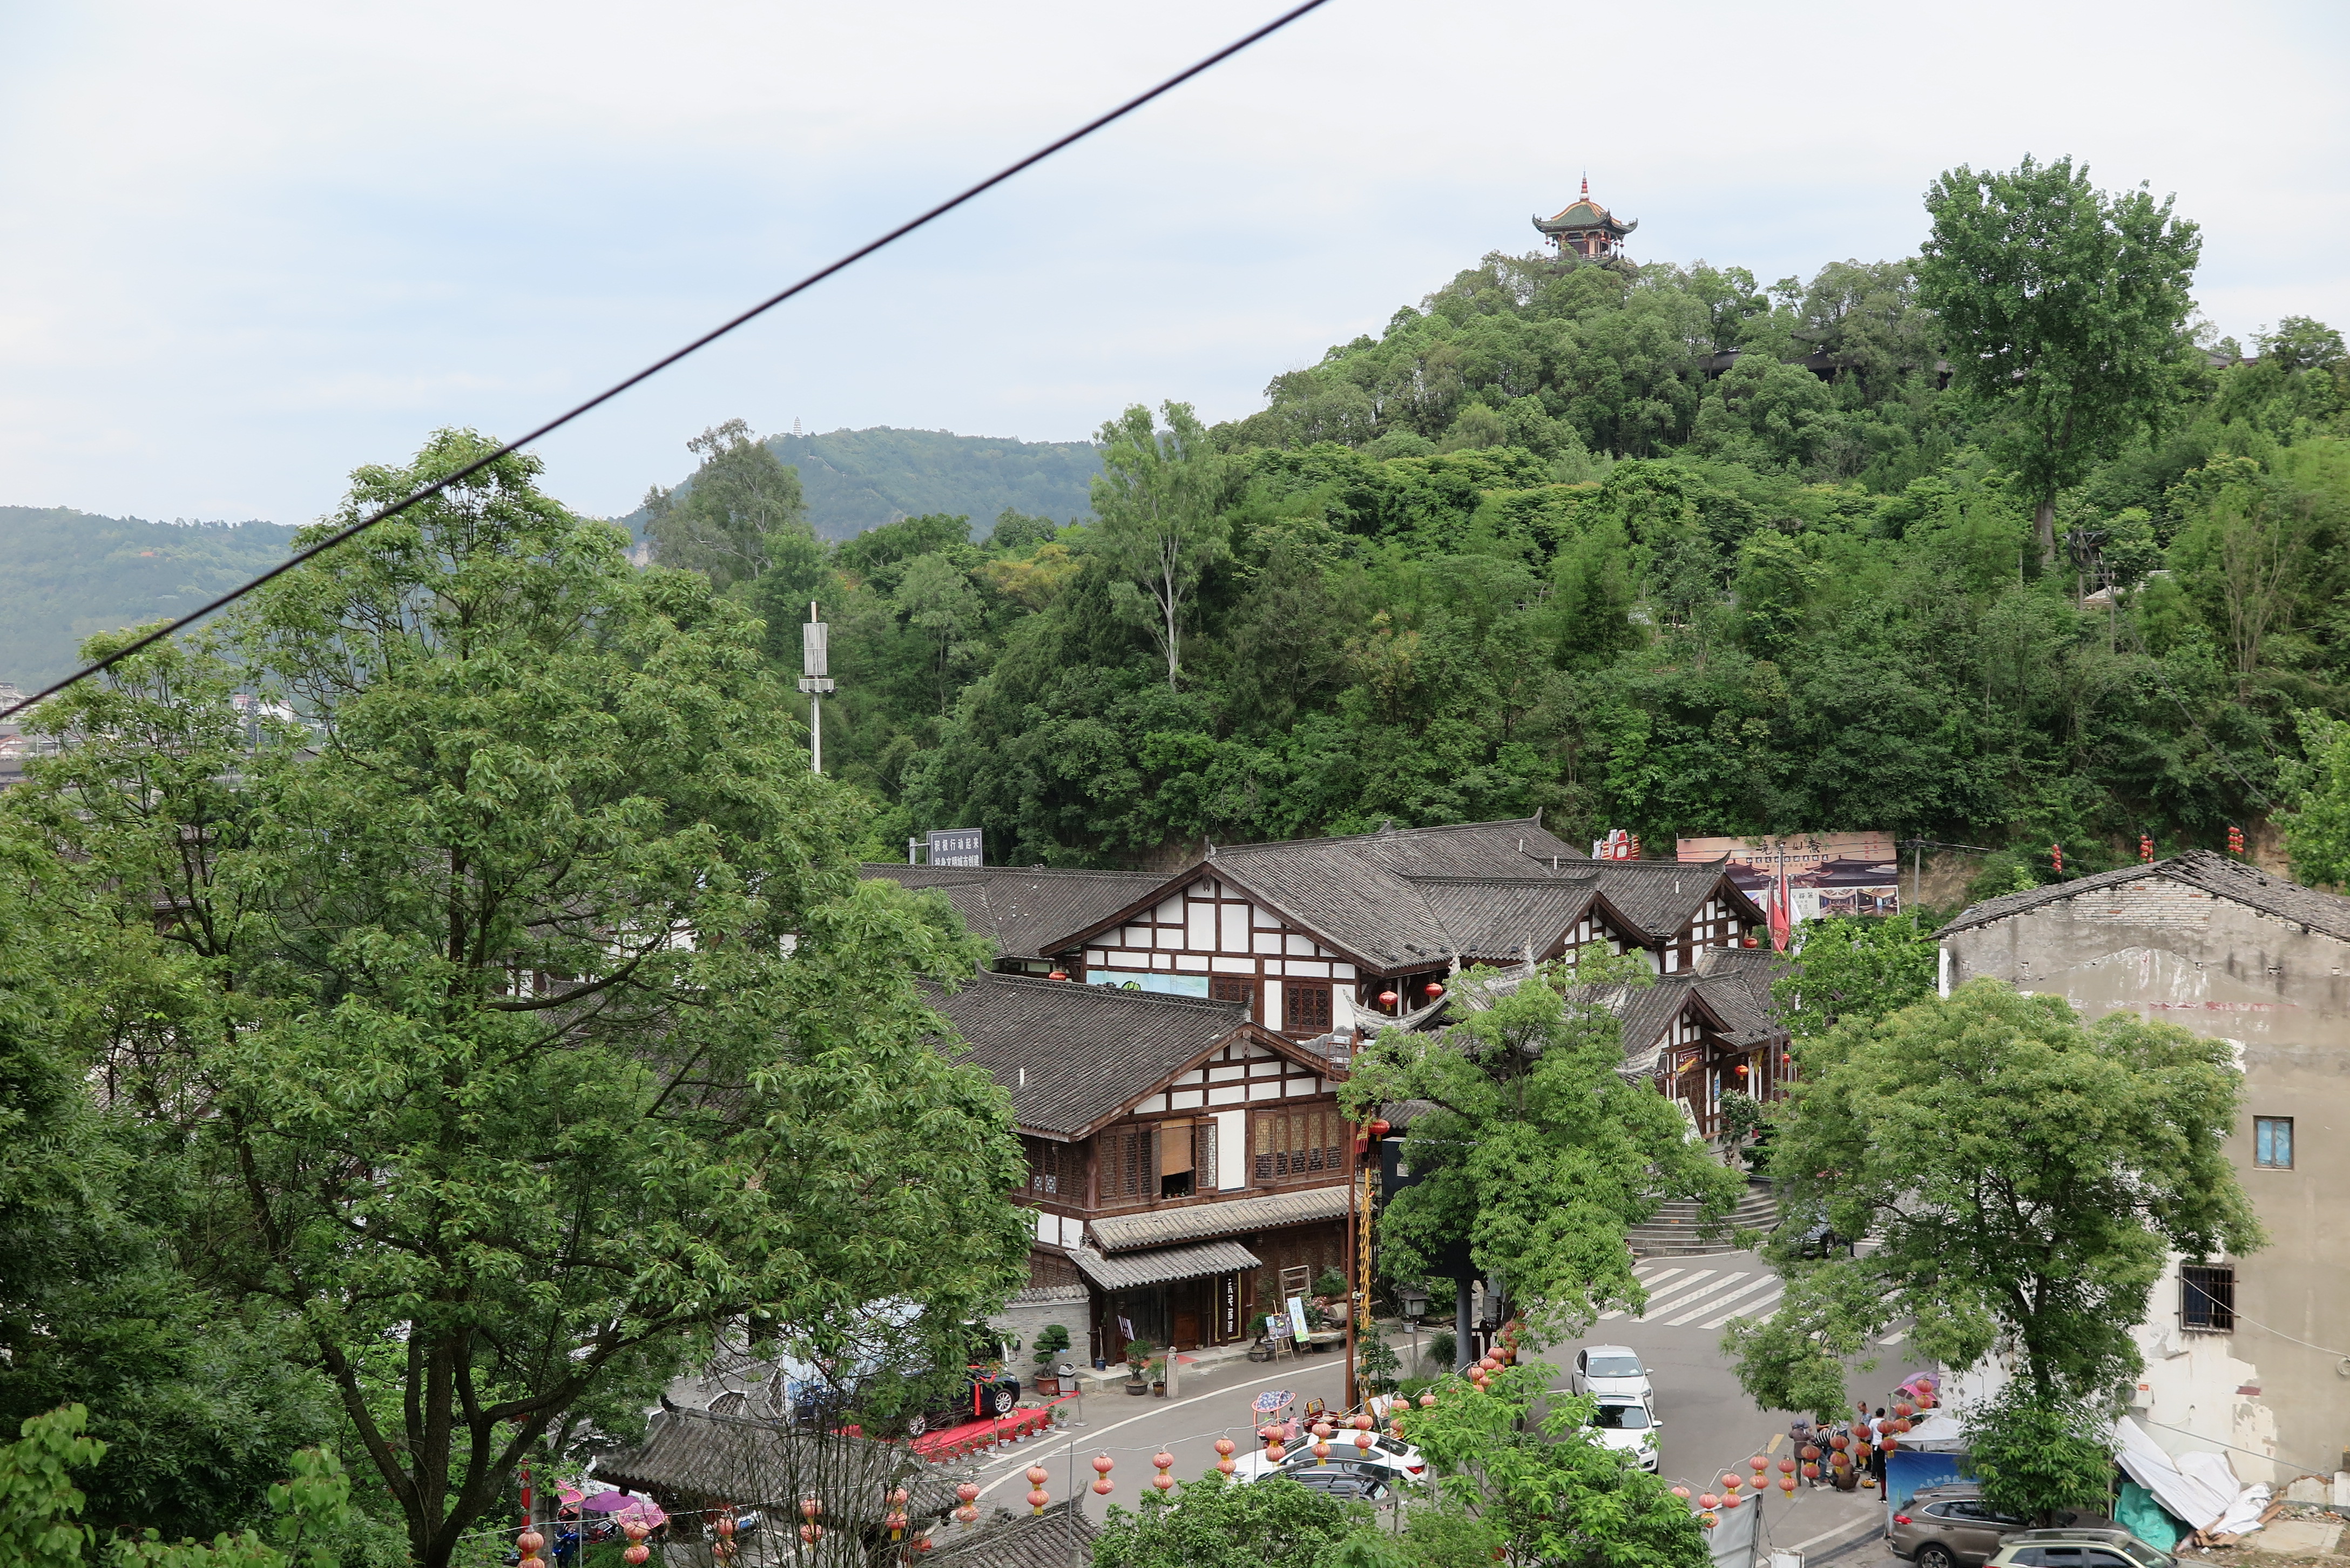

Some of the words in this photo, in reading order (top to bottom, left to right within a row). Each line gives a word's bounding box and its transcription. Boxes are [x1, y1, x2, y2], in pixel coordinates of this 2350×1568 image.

[934, 836, 979, 852] 积极行动起来
[935, 854, 980, 867] 投身文明城市创建
